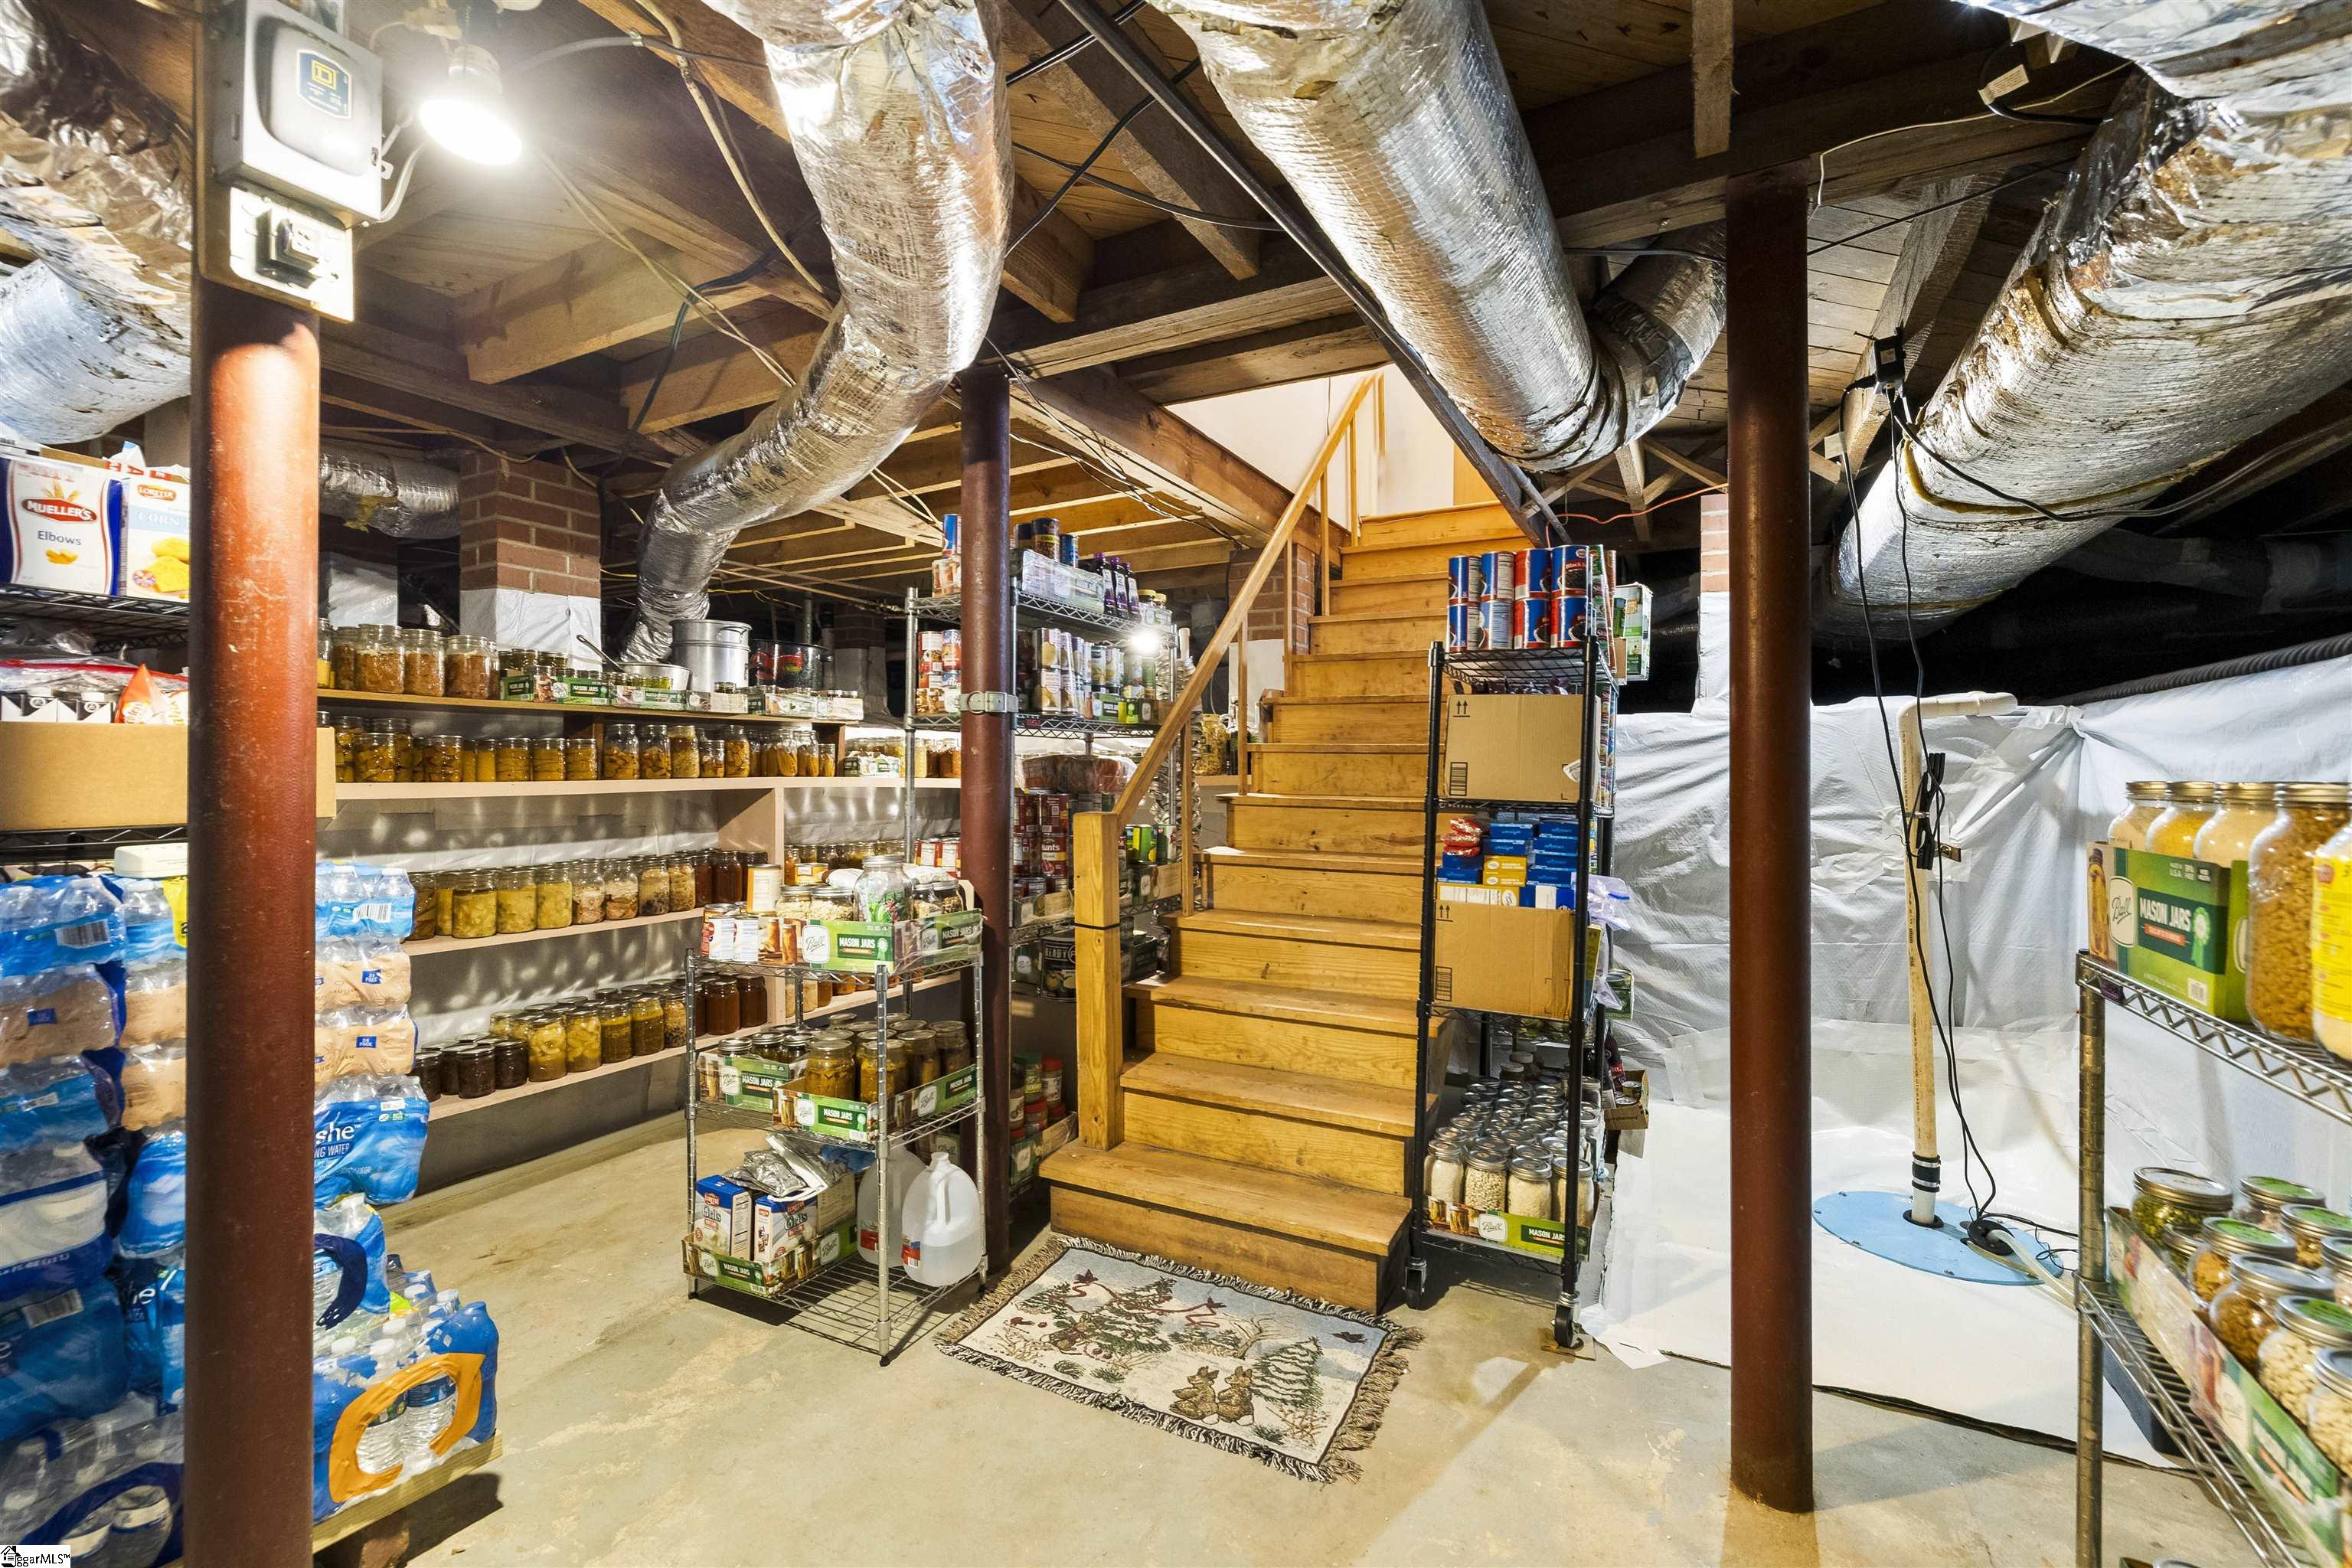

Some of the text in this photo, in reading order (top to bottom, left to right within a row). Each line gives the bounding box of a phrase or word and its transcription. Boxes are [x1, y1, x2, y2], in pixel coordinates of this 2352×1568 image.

[26, 500, 93, 521] MUELLER'S
[139, 511, 180, 527] CORN
[38, 530, 82, 546] Elbows
[2112, 895, 2132, 925] Ball
[2140, 897, 2192, 932] MASON JARS
[942, 929, 959, 939] MASON
[806, 936, 825, 952] Ball
[839, 937, 876, 948] MASON JARS
[742, 1075, 773, 1088] MASON JARS
[823, 1108, 853, 1121] MASON JARS
[328, 1142, 350, 1156] WATER
[702, 1205, 722, 1223] Grits
[785, 1212, 808, 1230] Grits
[1481, 1222, 1503, 1232] Ball
[1528, 1228, 1550, 1239] MASON
[723, 1263, 739, 1272] MASON
